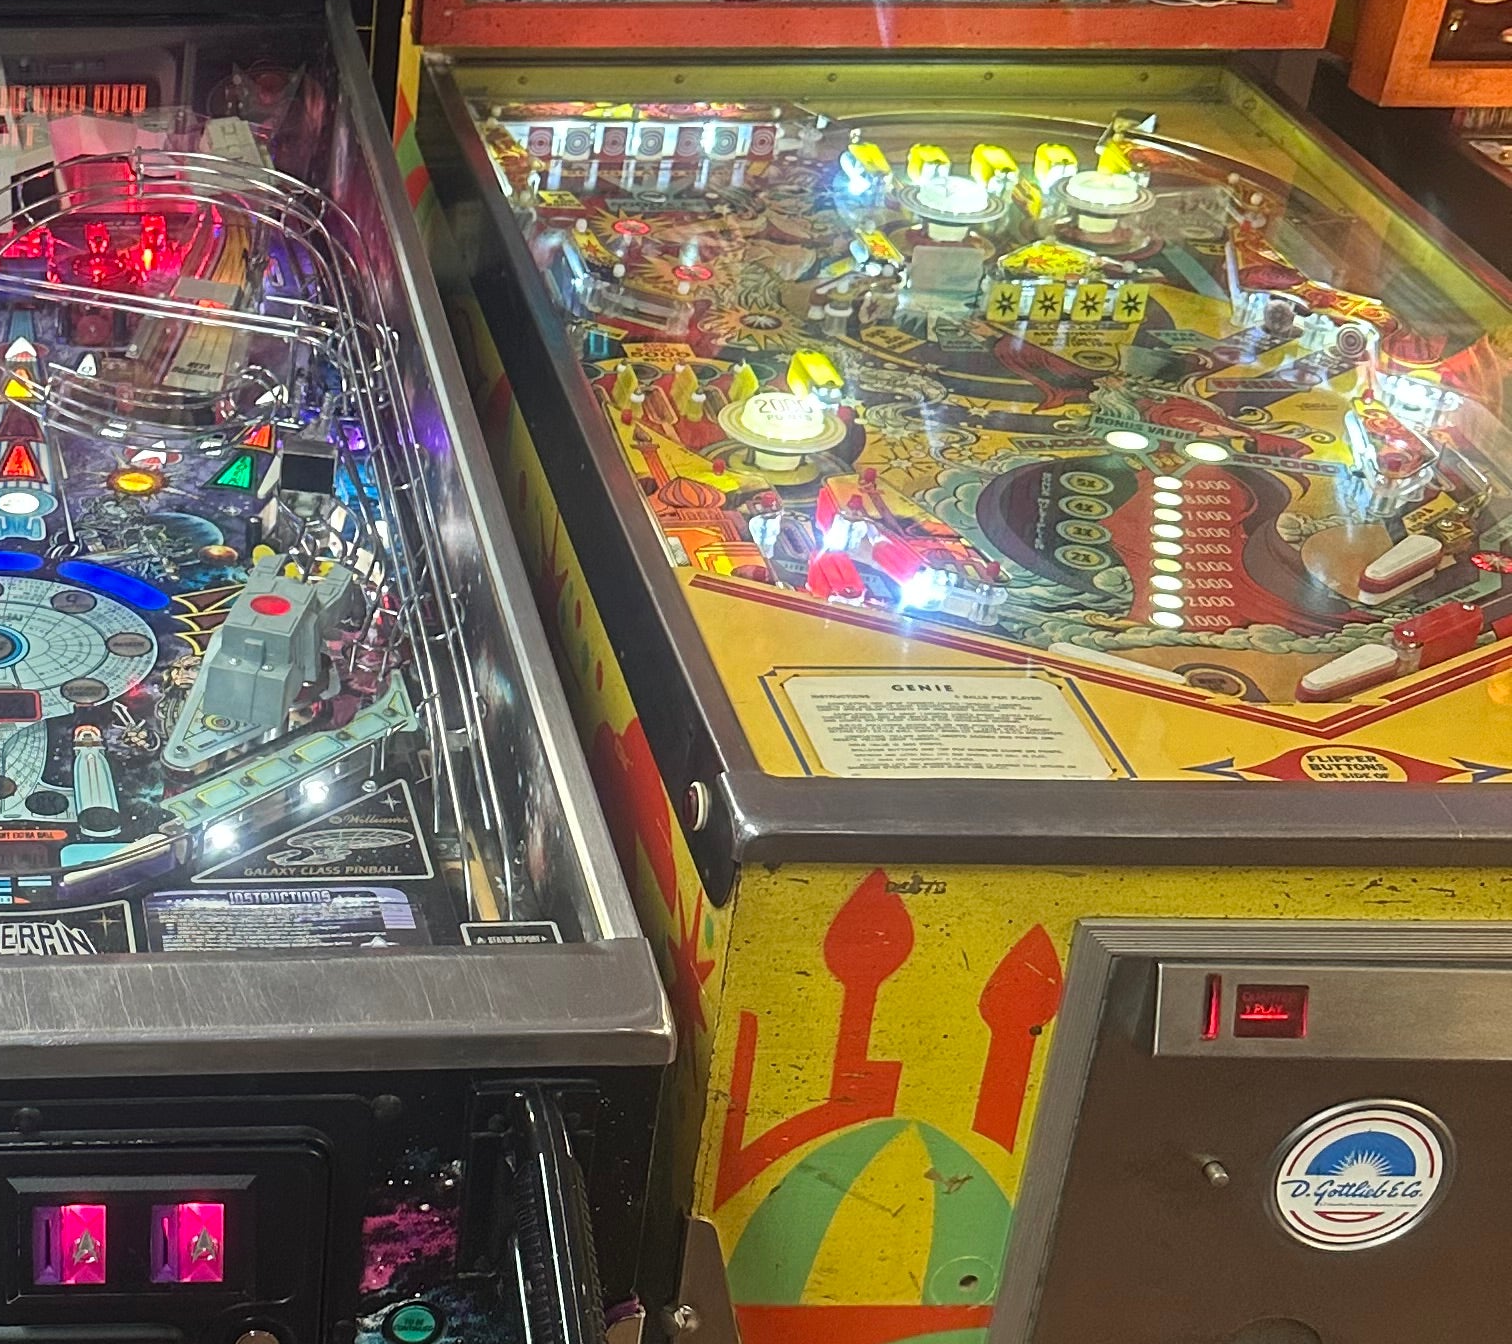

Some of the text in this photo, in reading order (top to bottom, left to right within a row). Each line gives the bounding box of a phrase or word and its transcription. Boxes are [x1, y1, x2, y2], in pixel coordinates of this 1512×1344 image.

[890, 684, 954, 692] GENIE
[1307, 755, 1378, 763] FLIPPER
[1310, 764, 1389, 772] BUTTONS
[244, 865, 402, 876] GALAXY CLASS PINBALL
[228, 890, 333, 905] INSTRUCTIONS
[1313, 1180, 1386, 1207] Gottlieb
